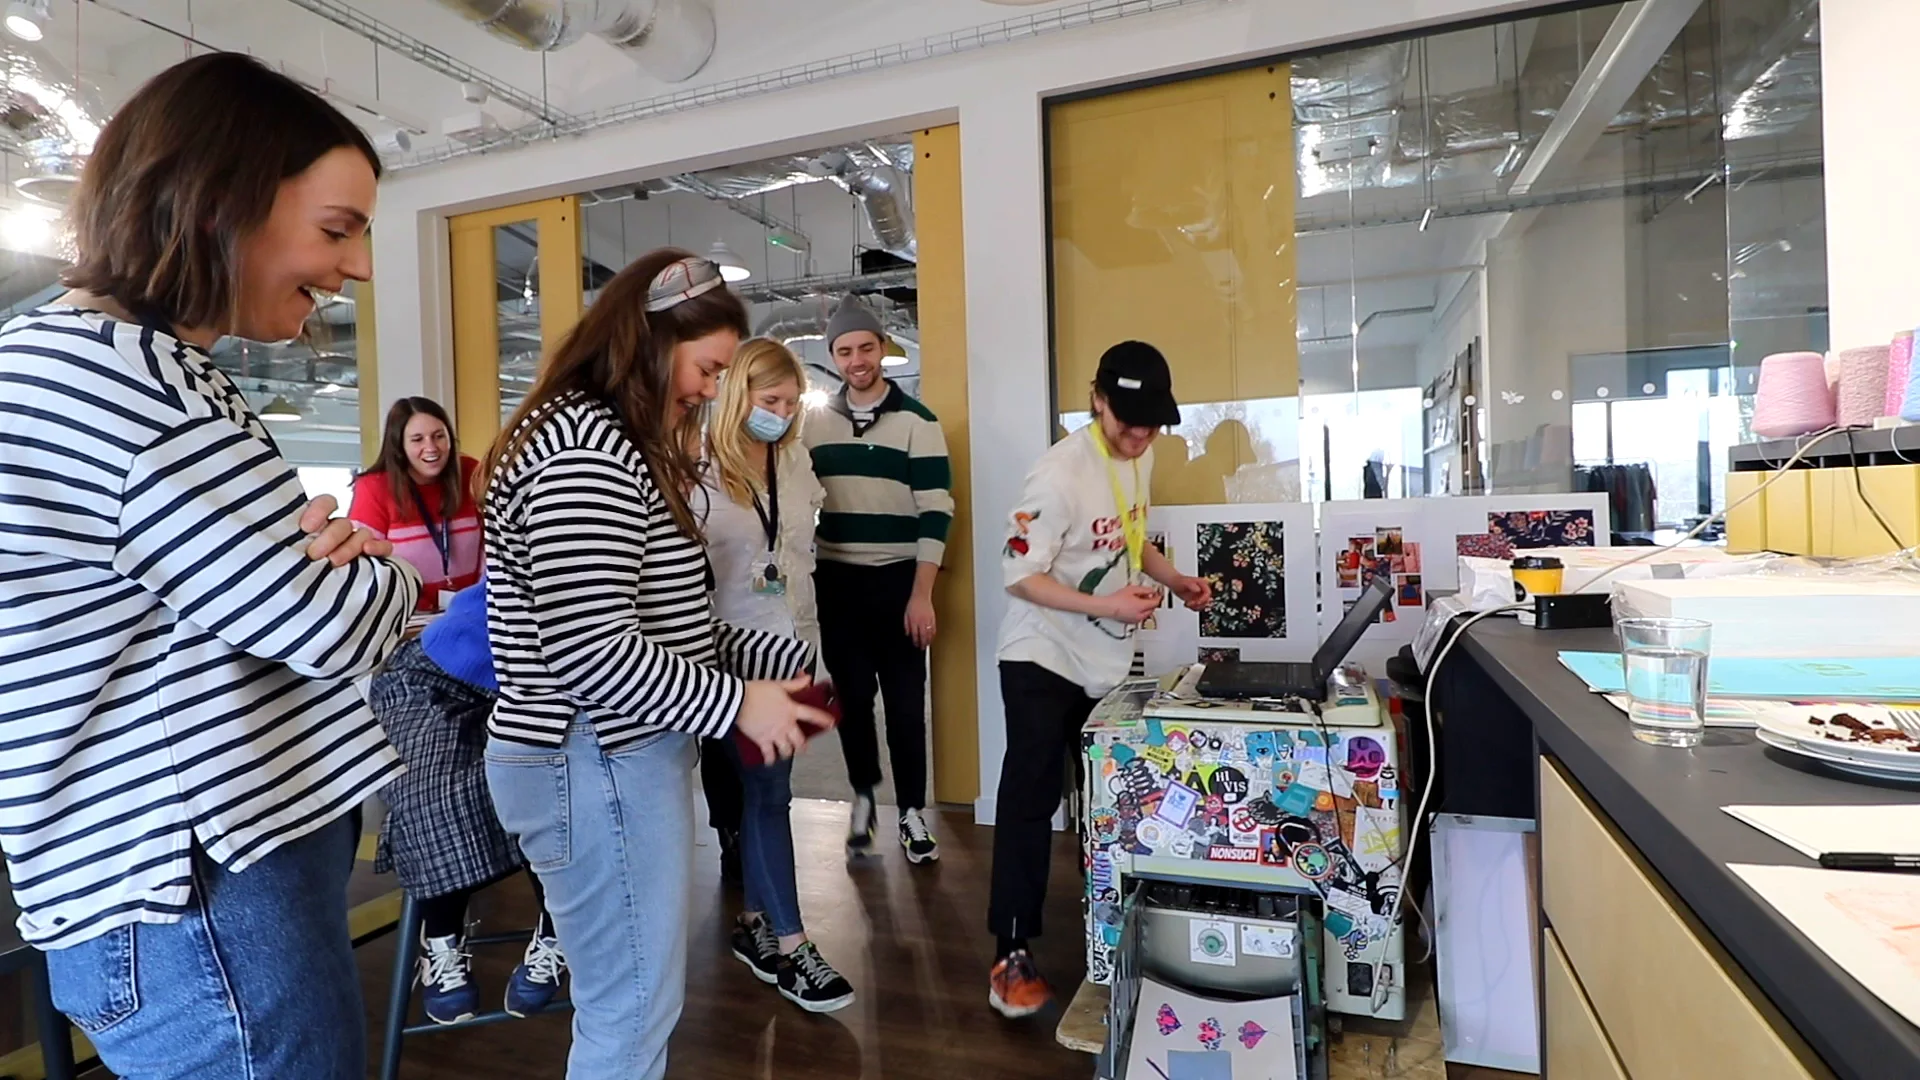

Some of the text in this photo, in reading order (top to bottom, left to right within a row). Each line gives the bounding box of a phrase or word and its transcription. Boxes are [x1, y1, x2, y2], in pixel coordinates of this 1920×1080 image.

[1215, 770, 1230, 782] HI
[1223, 781, 1247, 793] VIS
[1210, 847, 1257, 861] NONSUCH
